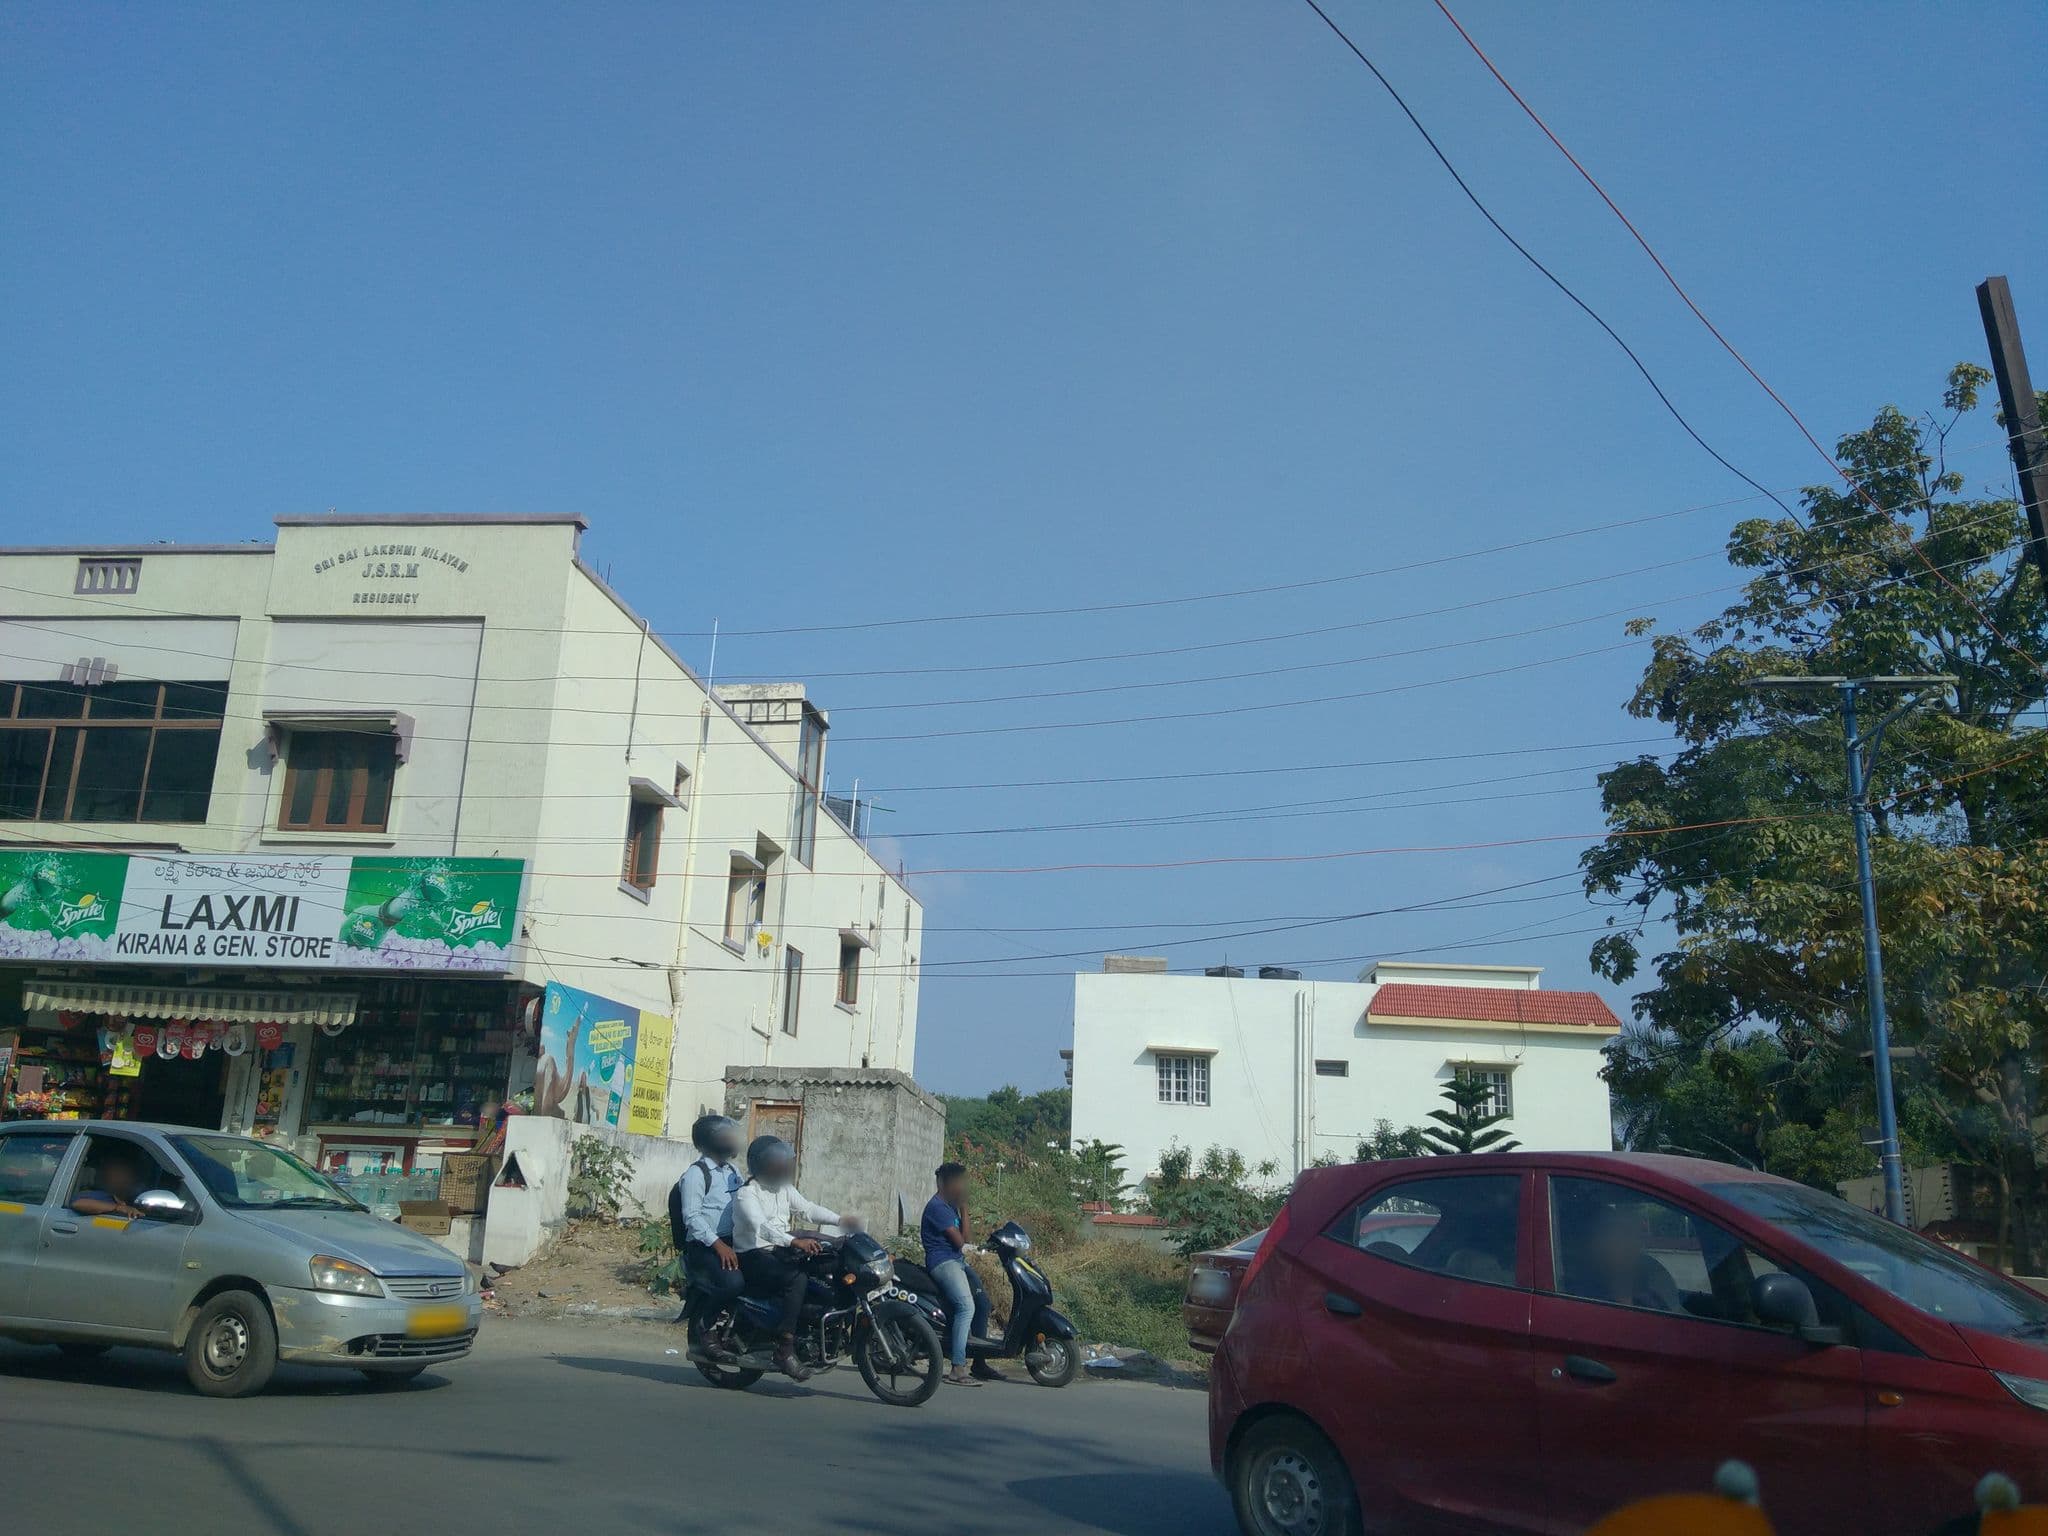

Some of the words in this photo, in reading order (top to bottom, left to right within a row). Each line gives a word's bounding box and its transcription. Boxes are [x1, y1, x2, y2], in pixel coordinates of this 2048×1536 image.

[314, 557, 336, 574] SRI
[338, 549, 359, 564] SAI
[363, 544, 418, 558] LAKSHMI
[421, 546, 469, 574] NILAYAM
[353, 592, 420, 604] RESIDENCY
[227, 862, 240, 878] &
[57, 902, 103, 926] Sprite
[160, 894, 300, 932] LAXMI
[450, 910, 498, 934] Sprite
[116, 933, 188, 956] KIRANA
[193, 934, 207, 957] &
[213, 935, 258, 957] GEN.
[265, 936, 333, 959] STORE
